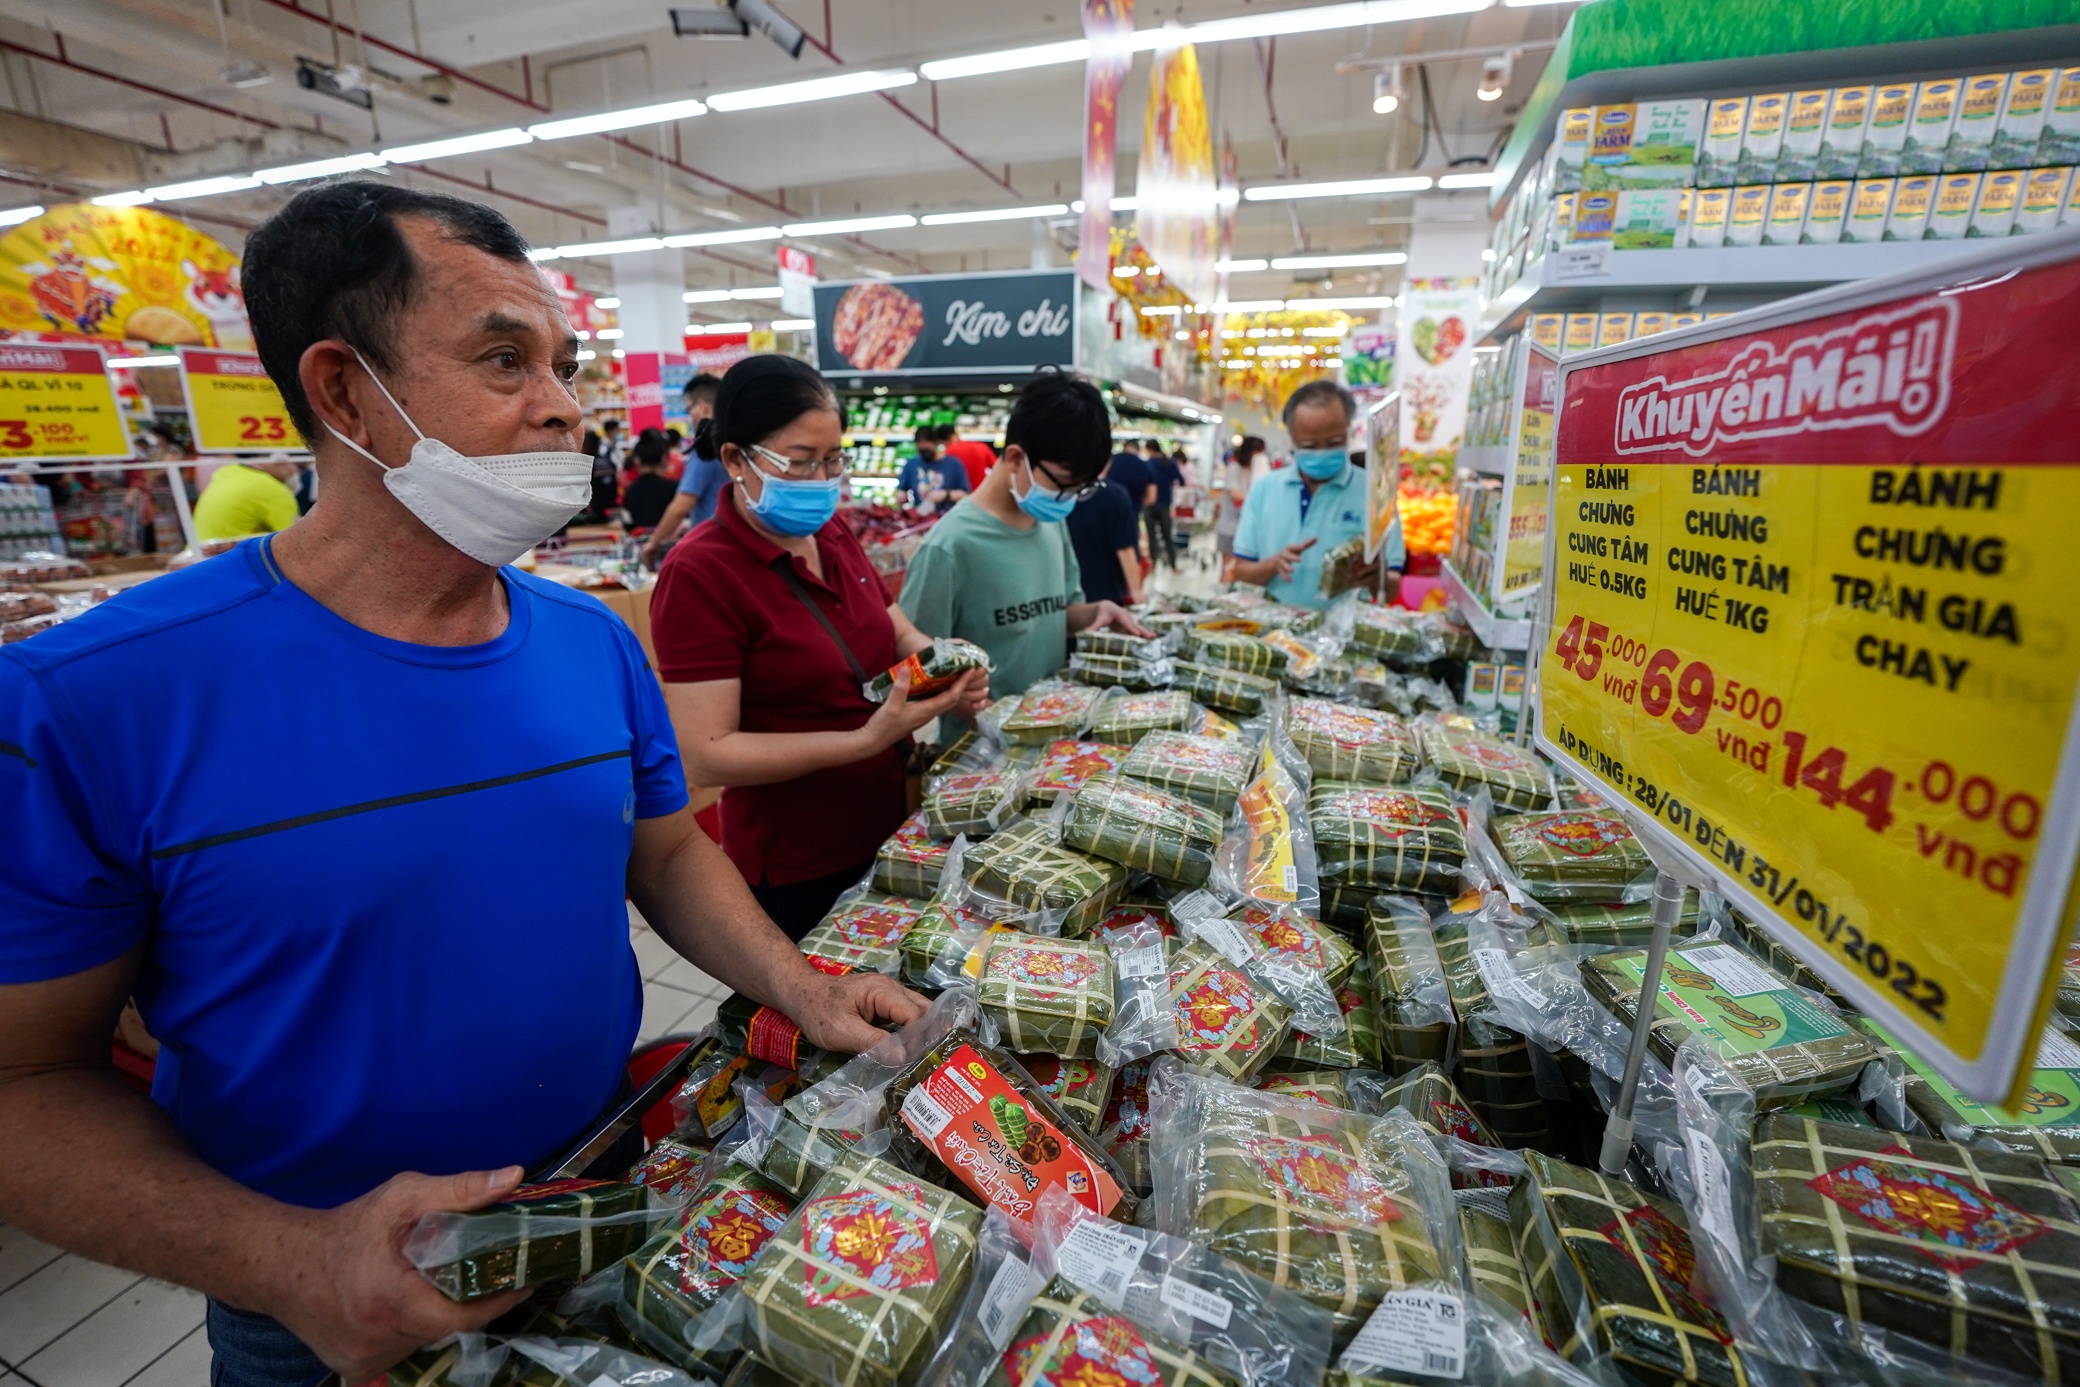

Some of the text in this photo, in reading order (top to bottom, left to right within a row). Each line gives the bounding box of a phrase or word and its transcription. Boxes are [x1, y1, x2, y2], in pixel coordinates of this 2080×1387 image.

[1594, 134, 1632, 148] FARM
[942, 298, 1071, 347] Kim chi
[238, 416, 287, 441] 23
[1586, 463, 1629, 491] BÁNH
[1692, 463, 1761, 498] BÁNH
[1869, 462, 2002, 511] BÁNH
[1579, 500, 1635, 527] CHƯNG
[1685, 508, 1768, 544] CHƯNG
[1568, 532, 1649, 566] CUNG TÂM
[1854, 524, 2006, 577] CHƯNG
[1569, 561, 1647, 600] HUẾ 0.5KG
[1667, 547, 1791, 595] CUNG TÂM
[1675, 586, 1769, 634] HUẾ 1KG
[1938, 594, 2022, 647] GIA
[1855, 634, 1971, 693] CHAY
[1603, 671, 1639, 706] vnđ
[1717, 727, 1773, 774] vnđ
[1558, 722, 1576, 752] ÁP
[1578, 738, 1624, 786] DỤNG
[1634, 776, 1692, 833] 28/01
[1695, 816, 1746, 875] ĐẾN
[1747, 855, 1947, 1023] 31/01/2022
[1916, 822, 2025, 901] vnđ
[992, 1180, 1033, 1219] Bánh
